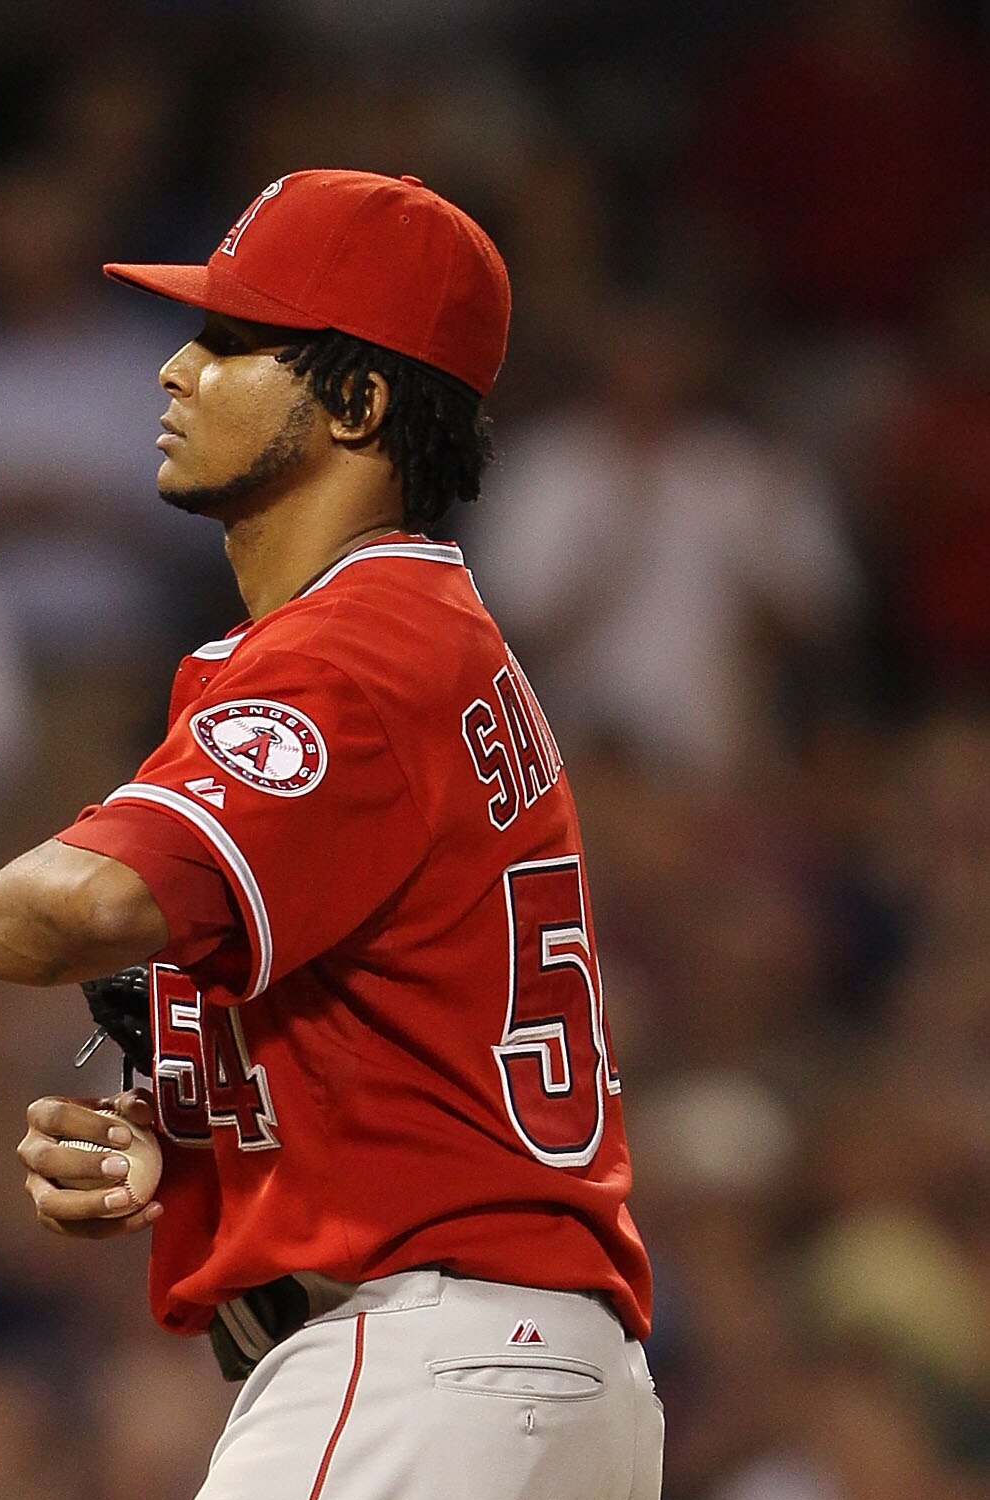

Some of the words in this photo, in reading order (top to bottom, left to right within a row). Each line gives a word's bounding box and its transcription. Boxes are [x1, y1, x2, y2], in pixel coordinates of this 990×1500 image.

[228, 706, 317, 754] ANGELS
[462, 642, 564, 832] SA
[153, 962, 282, 1152] 54
[491, 855, 622, 1168] 5
